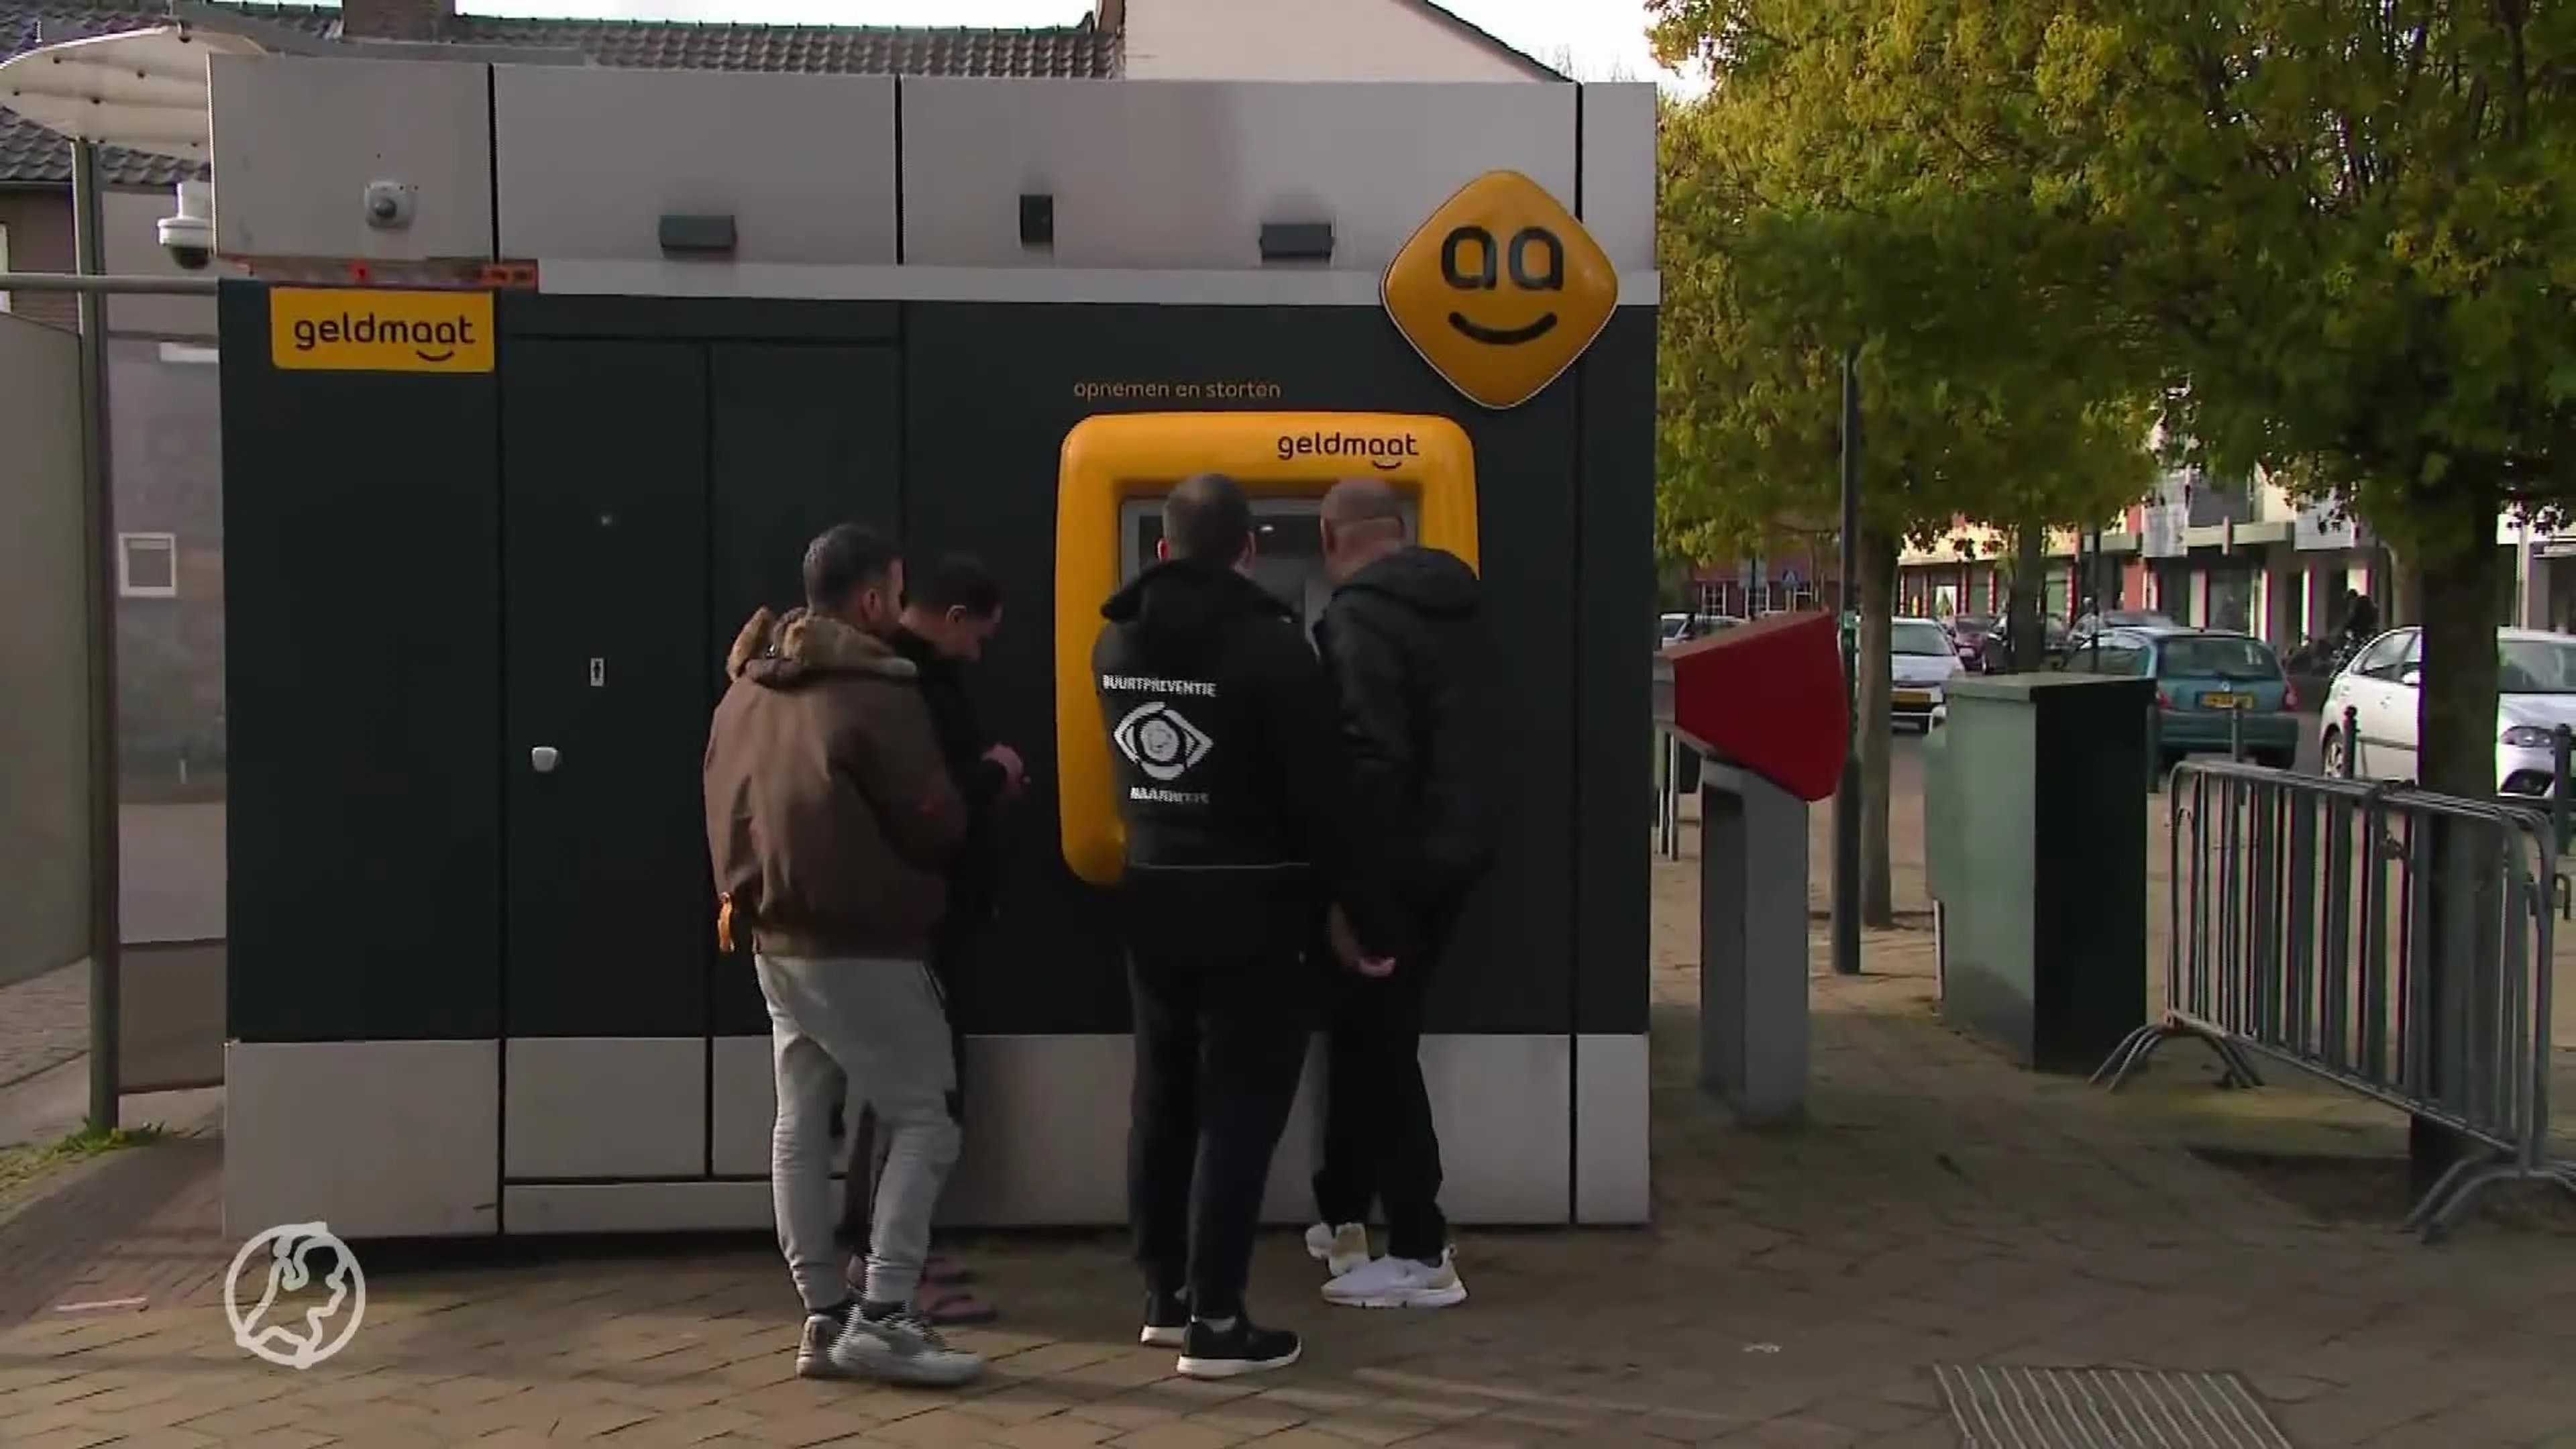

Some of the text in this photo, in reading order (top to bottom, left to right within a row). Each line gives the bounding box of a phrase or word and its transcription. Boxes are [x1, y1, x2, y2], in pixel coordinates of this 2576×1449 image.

[294, 311, 476, 351] geldmaat
[1073, 381, 1280, 402] opnemen en storten
[1277, 432, 1419, 460] geldmaat
[1102, 674, 1217, 698] BUURTPREVENTIE
